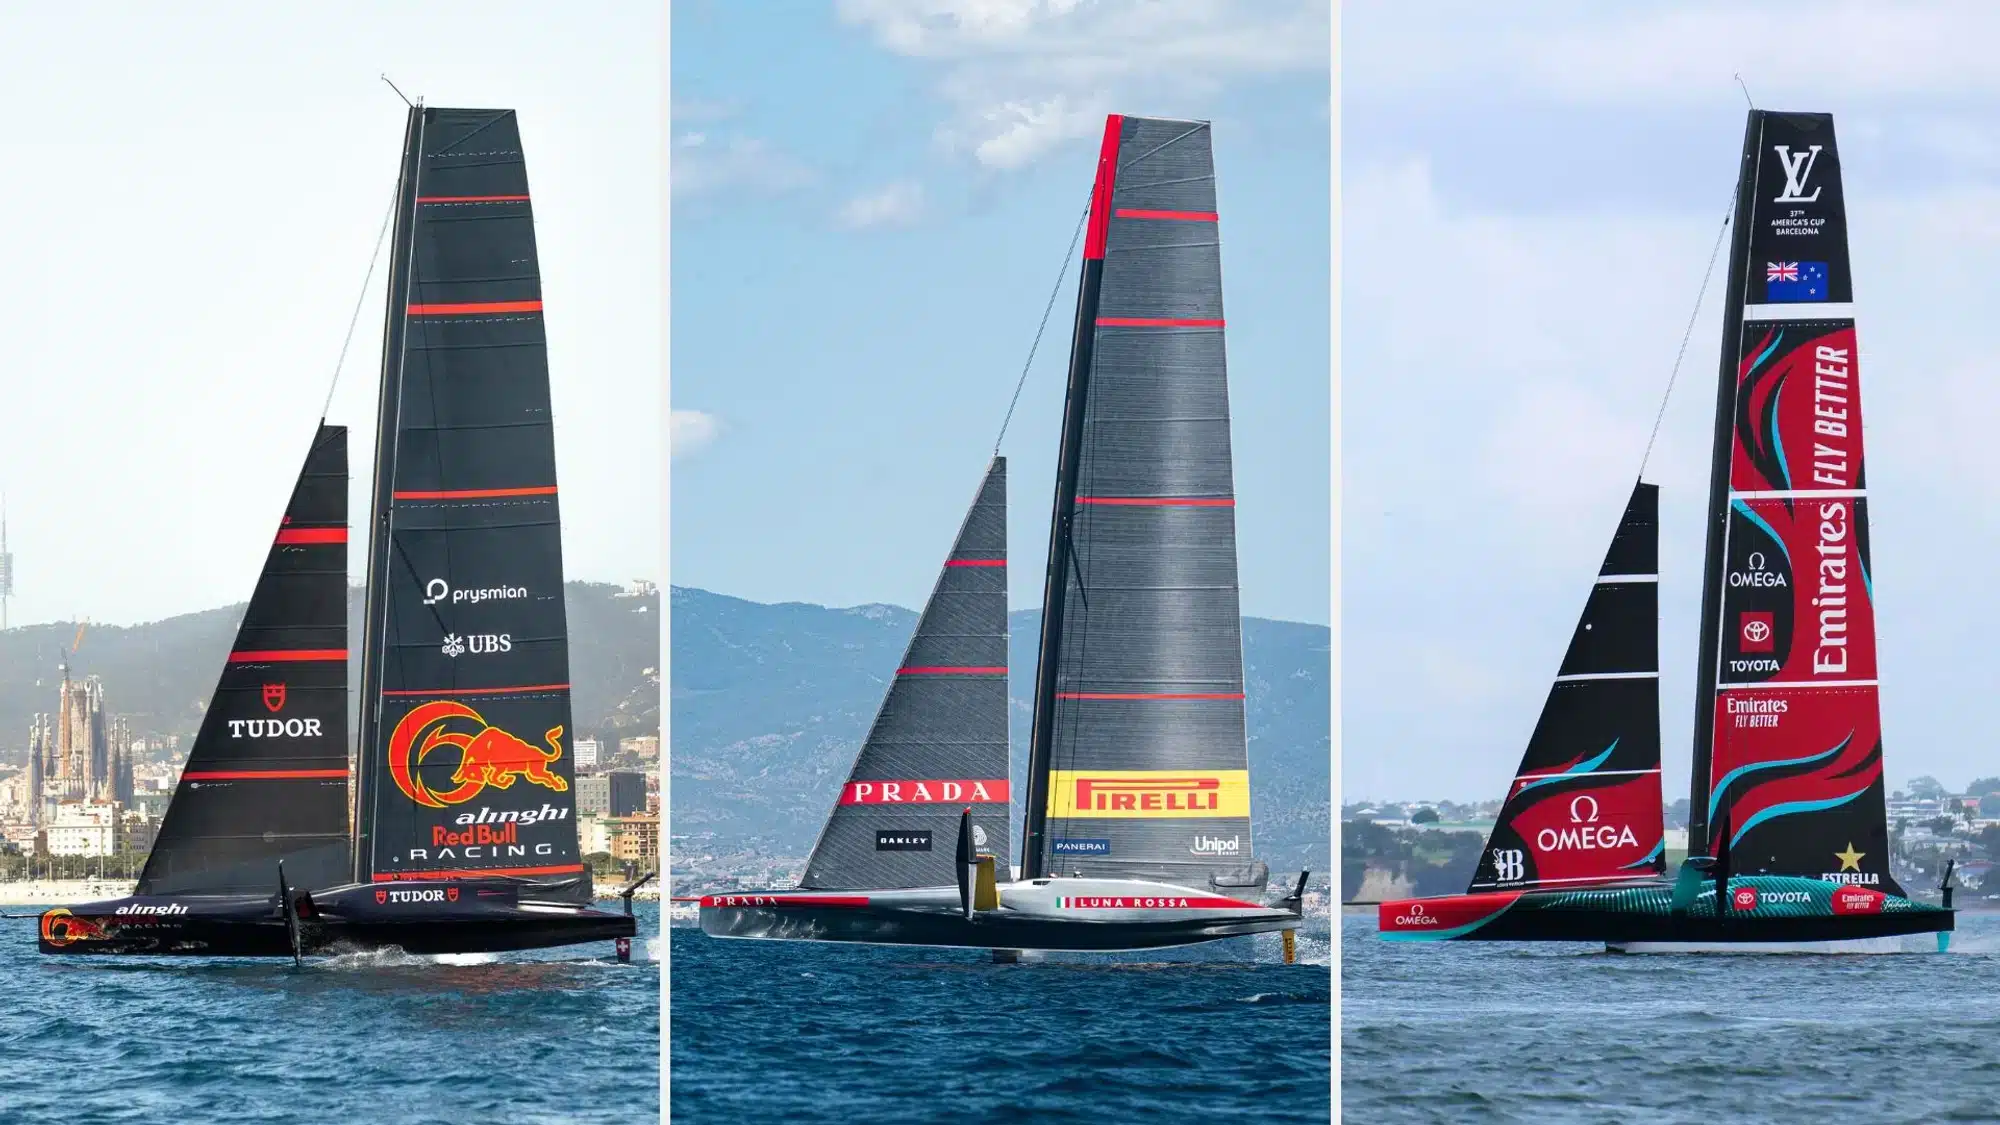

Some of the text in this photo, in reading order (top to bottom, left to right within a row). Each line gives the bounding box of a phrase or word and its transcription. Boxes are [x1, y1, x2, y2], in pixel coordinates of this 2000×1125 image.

[1771, 218, 1826, 227] AMERICA'S CUP
[1776, 228, 1819, 236] BARCELONA
[1812, 345, 1848, 675] Emirates FLY BETTER
[1730, 572, 1787, 587] OMEGA
[453, 585, 528, 604] prysmian
[467, 634, 512, 653] UBS
[1730, 660, 1780, 672] TOYOTA
[1727, 698, 1788, 714] Emirates
[228, 718, 323, 738] TUDOR
[1736, 714, 1779, 728] FLY BETTER
[854, 782, 991, 802] PRADA
[1076, 778, 1220, 810] PIRELLI
[432, 822, 517, 847] Red Bull
[1537, 825, 1639, 851] OMEGA
[410, 843, 553, 860] RACING
[1056, 842, 1106, 851] PANERAI
[1194, 835, 1239, 856] Unipol
[1822, 873, 1880, 885] ESTRELLA
[390, 890, 445, 903] TUDOR
[713, 896, 778, 906] PRADA
[1080, 898, 1189, 908] LUNA ROSSA
[1760, 892, 1812, 903] TOYOTA
[1842, 894, 1875, 903] Emirates
[1395, 916, 1438, 925] OMEGA
